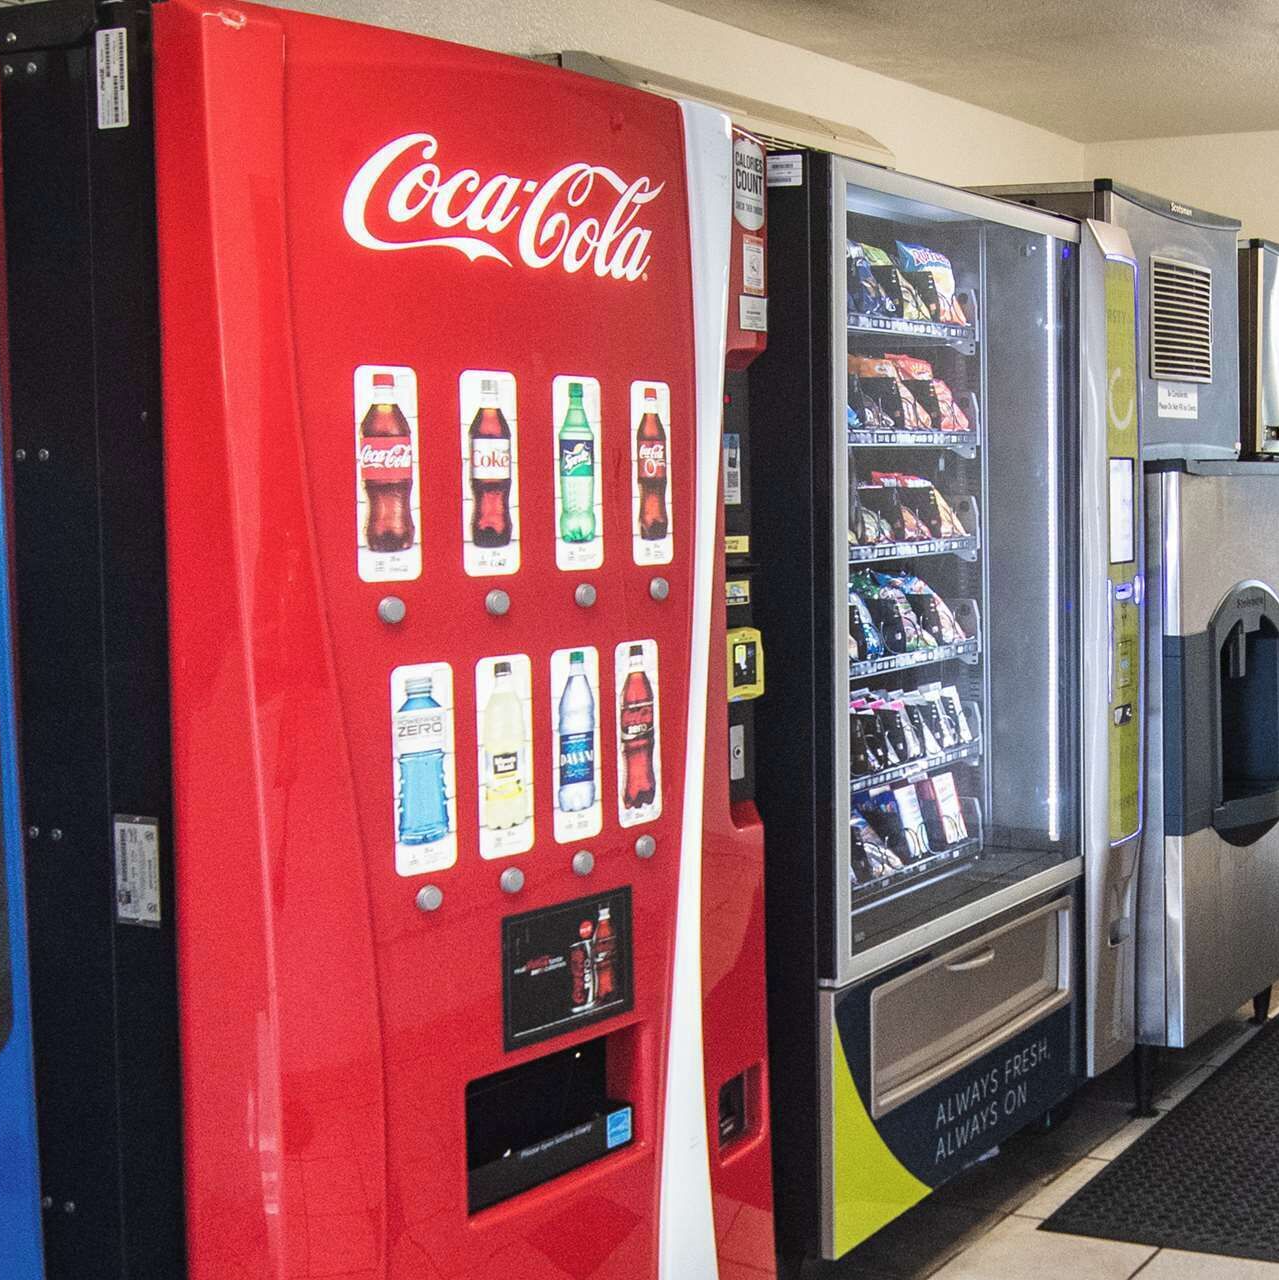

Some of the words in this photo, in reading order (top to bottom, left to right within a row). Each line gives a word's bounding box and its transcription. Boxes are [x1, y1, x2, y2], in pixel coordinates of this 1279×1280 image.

[735, 151, 763, 173] CALORIES
[735, 168, 762, 196] COUNT
[342, 132, 665, 281] Coca-Cola
[1171, 202, 1193, 217] Scotsman
[357, 444, 412, 469] Coca-Cola
[397, 721, 444, 738] ZERO
[936, 1068, 998, 1130] ALWAYS
[936, 1101, 998, 1164] ALWAYS
[1004, 1081, 1028, 1115] ON
